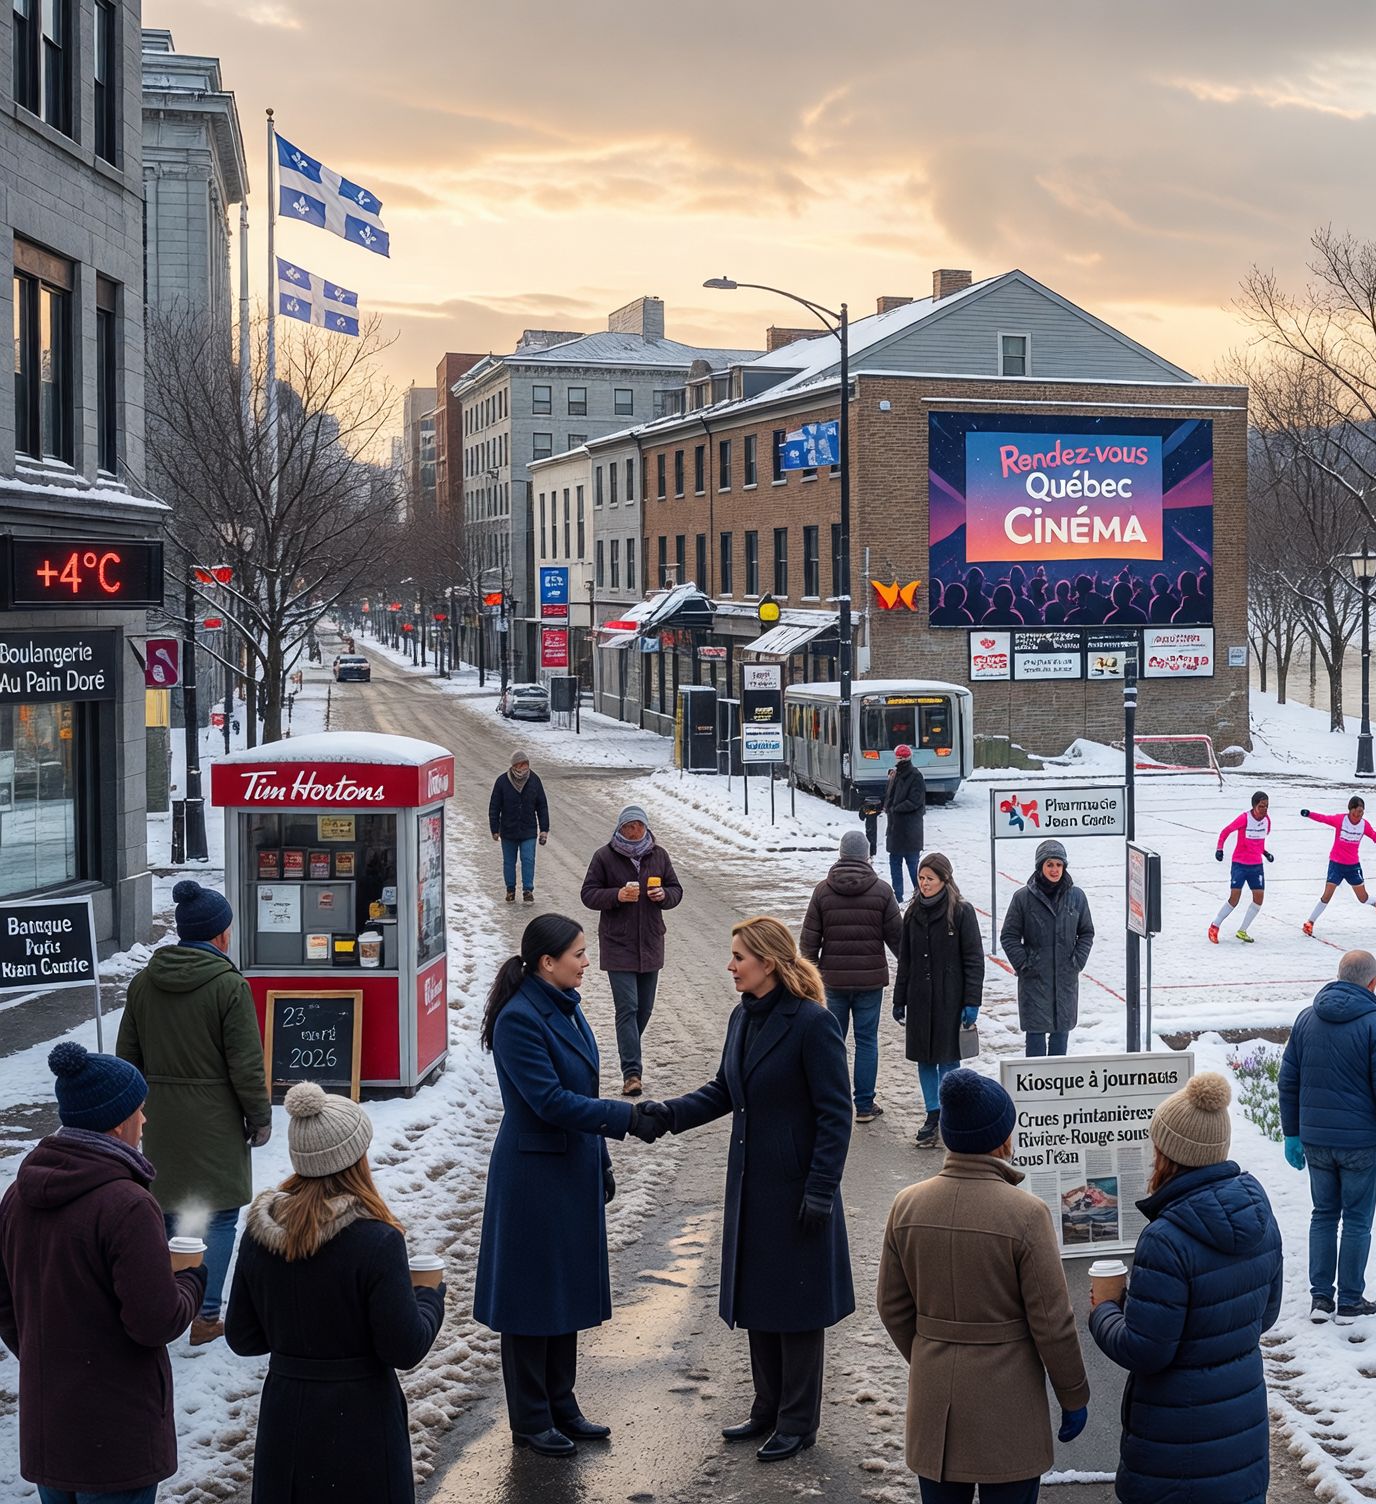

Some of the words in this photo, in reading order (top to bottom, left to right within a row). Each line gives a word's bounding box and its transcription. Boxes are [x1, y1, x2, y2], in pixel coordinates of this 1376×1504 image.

[1000, 440, 1148, 478] Rendez-vous
[1026, 469, 1132, 502] Québec
[36, 552, 121, 593] +4°C
[0, 641, 93, 668] Boulangerie
[0, 673, 21, 693] Au
[26, 671, 61, 693] Pain
[67, 669, 105, 691] Doré
[240, 771, 285, 800] Tim
[290, 771, 385, 800] Hortons
[282, 1006, 306, 1028] 23
[289, 1048, 337, 1068] 2026
[1016, 1073, 1084, 1096] Kiosque
[1088, 1070, 1099, 1088] à
[1018, 1111, 1059, 1128] Crues
